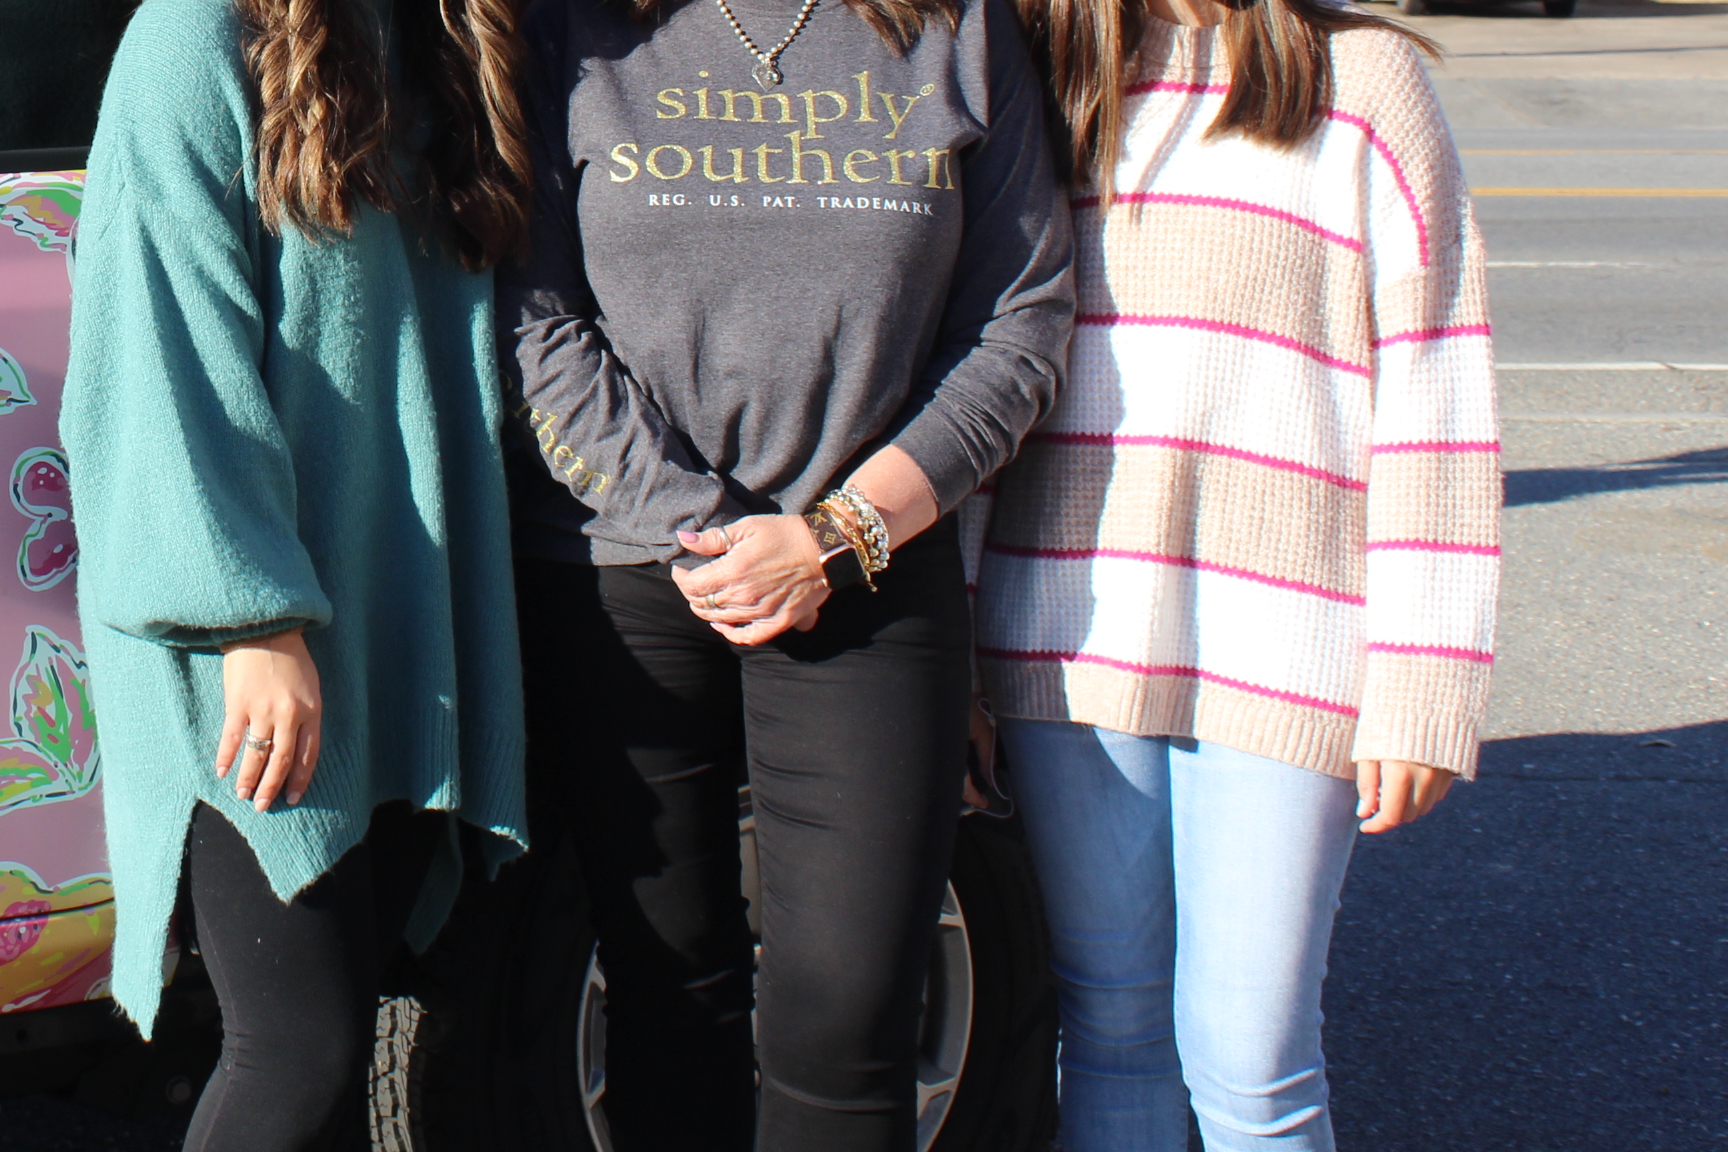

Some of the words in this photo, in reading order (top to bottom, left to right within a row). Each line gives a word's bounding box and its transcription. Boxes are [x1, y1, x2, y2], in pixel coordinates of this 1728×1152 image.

[609, 129, 955, 190] southern
[648, 193, 692, 207] REG.
[708, 194, 746, 208] U.S.
[762, 194, 801, 209] PAT.
[816, 195, 935, 216] TRADEMARK
